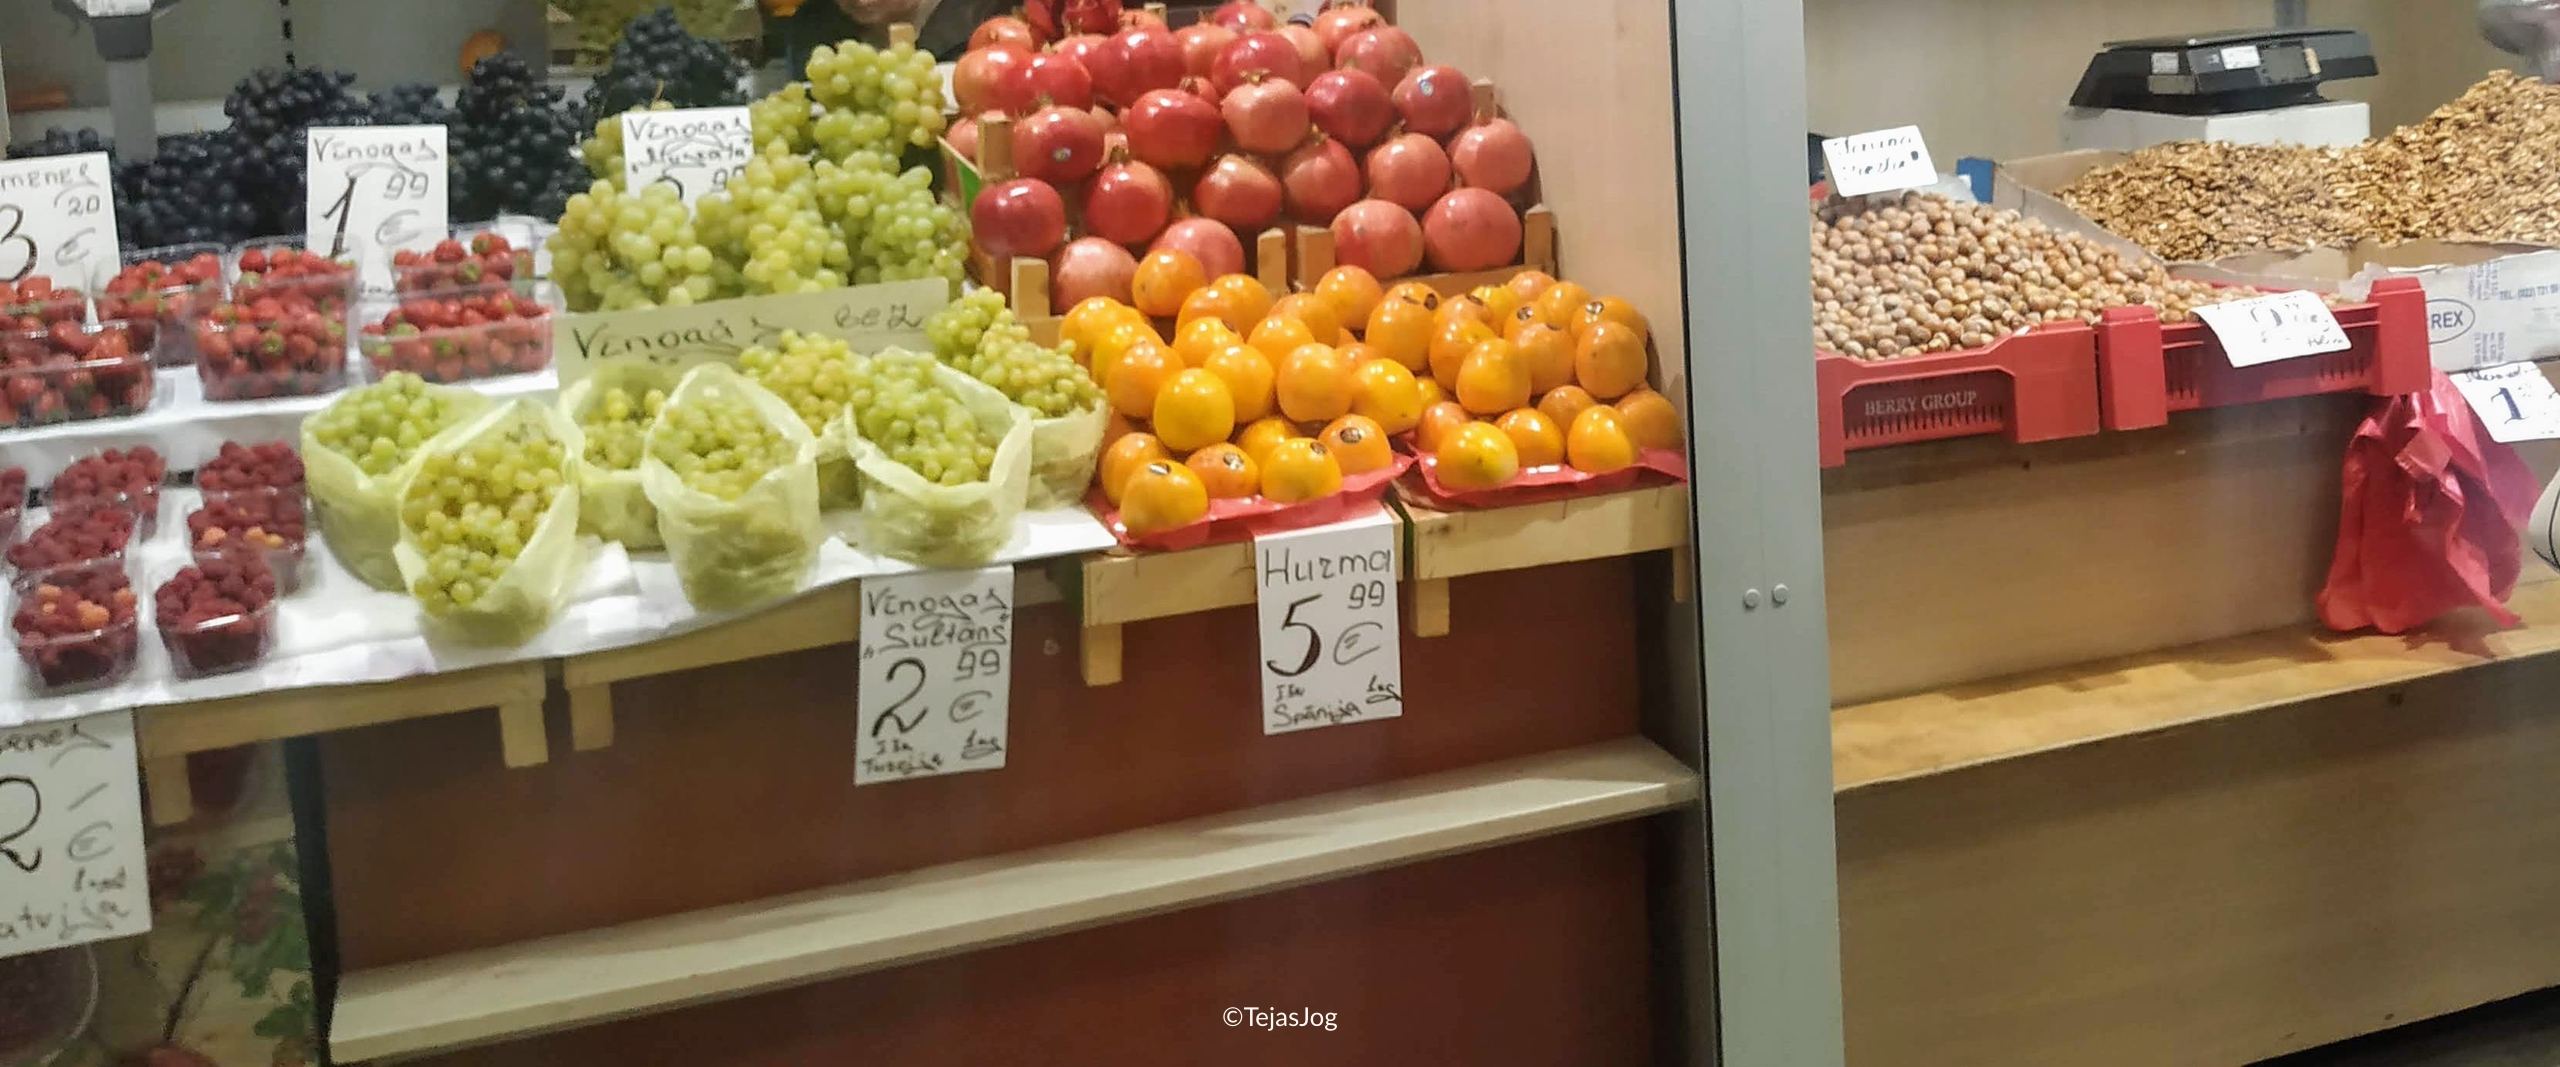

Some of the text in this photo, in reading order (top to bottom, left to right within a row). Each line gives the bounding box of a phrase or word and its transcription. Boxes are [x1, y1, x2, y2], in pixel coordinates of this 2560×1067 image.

[322, 172, 429, 258] 1 99
[0, 194, 100, 282] 3 20
[2431, 311, 2463, 330] REX
[1865, 390, 1977, 416] BERRY GROUP
[2491, 387, 2529, 424] 1
[1265, 548, 1390, 586] Hurma
[1266, 580, 1385, 676] 5 99
[1333, 621, 1384, 665] €
[872, 649, 1001, 738] 2 99
[949, 690, 992, 723] €
